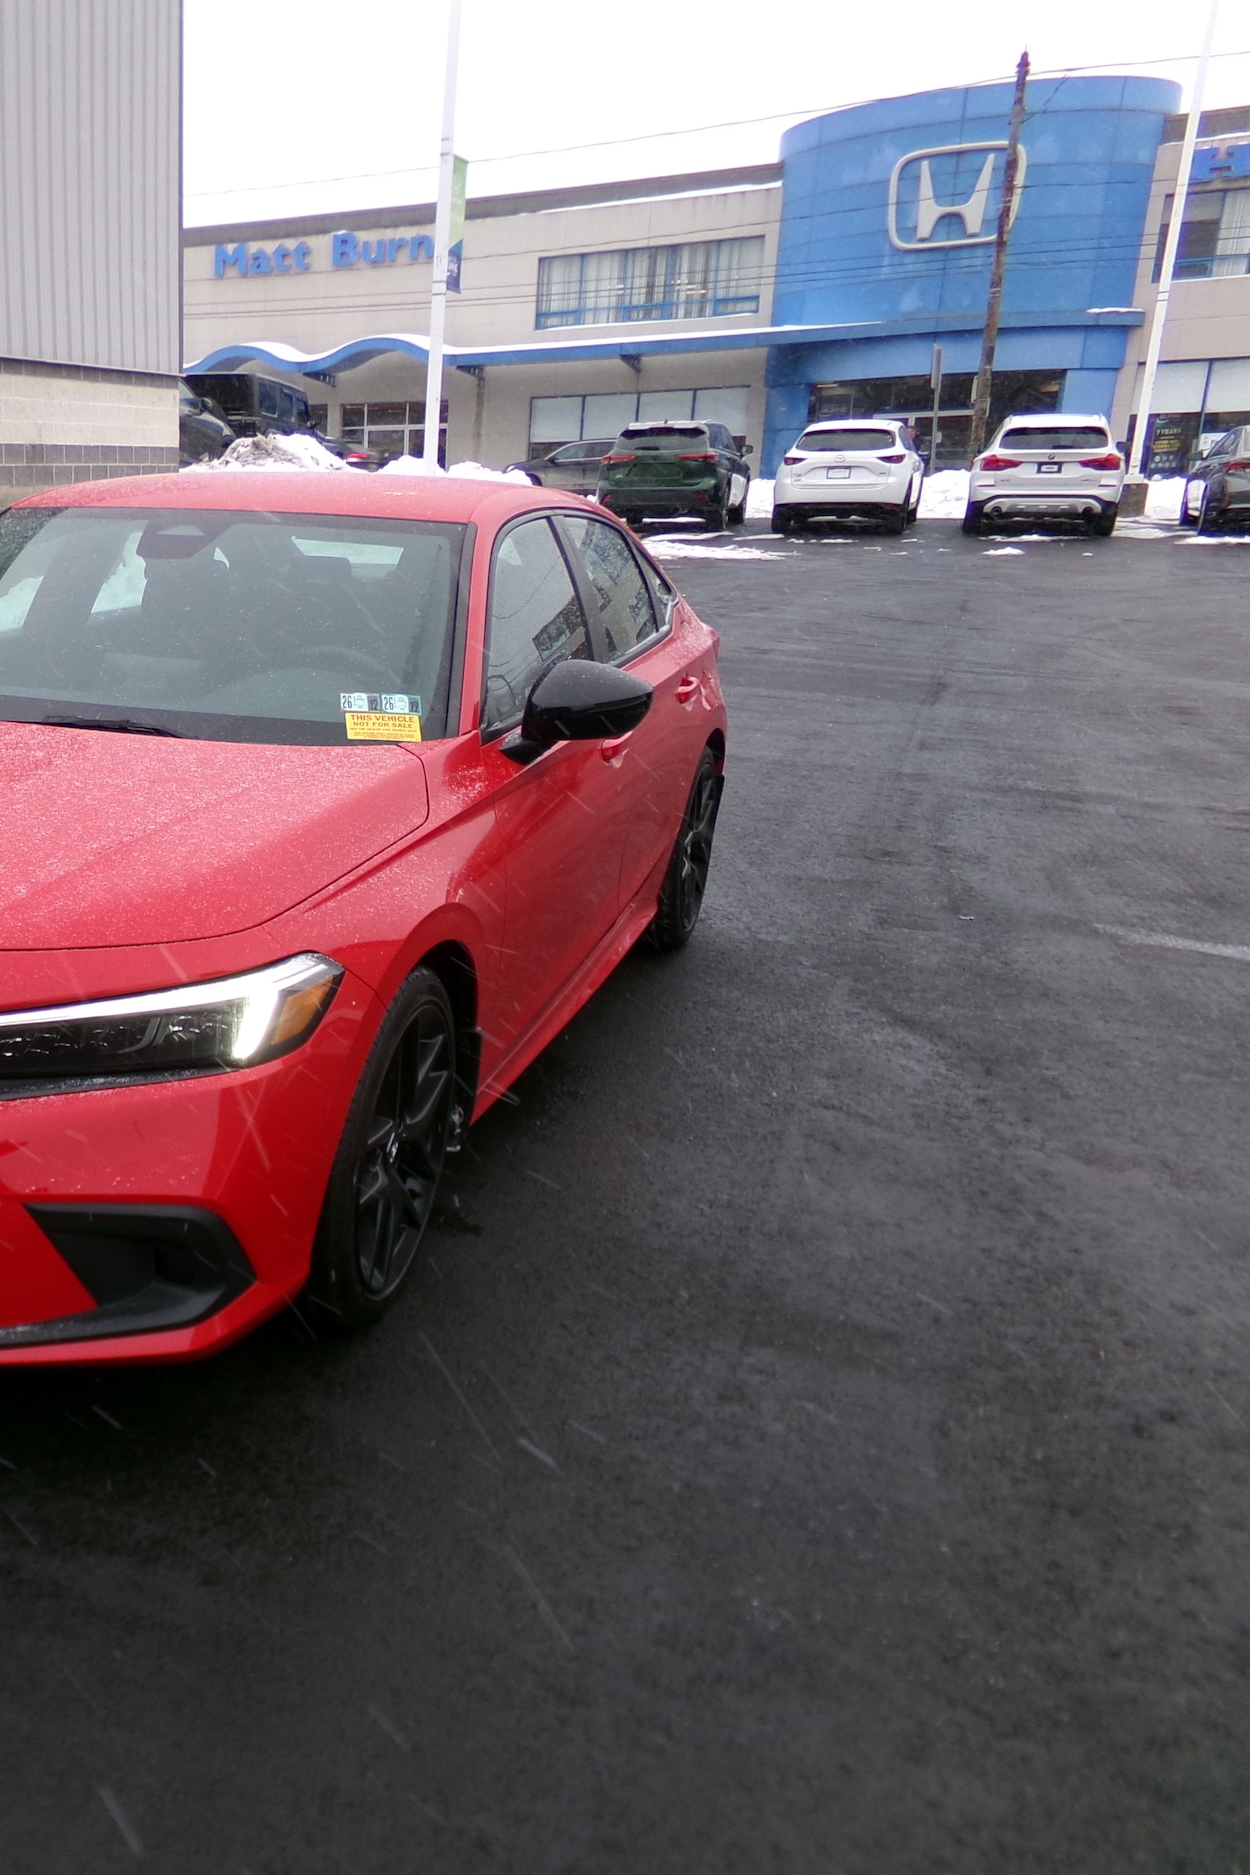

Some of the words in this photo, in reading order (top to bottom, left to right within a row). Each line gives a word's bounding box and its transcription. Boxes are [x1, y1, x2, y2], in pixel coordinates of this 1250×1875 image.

[214, 240, 311, 278] Matt
[332, 231, 435, 268] Burn
[342, 695, 353, 709] 26
[384, 696, 394, 710] 26
[374, 715, 415, 723] VEHICLE
